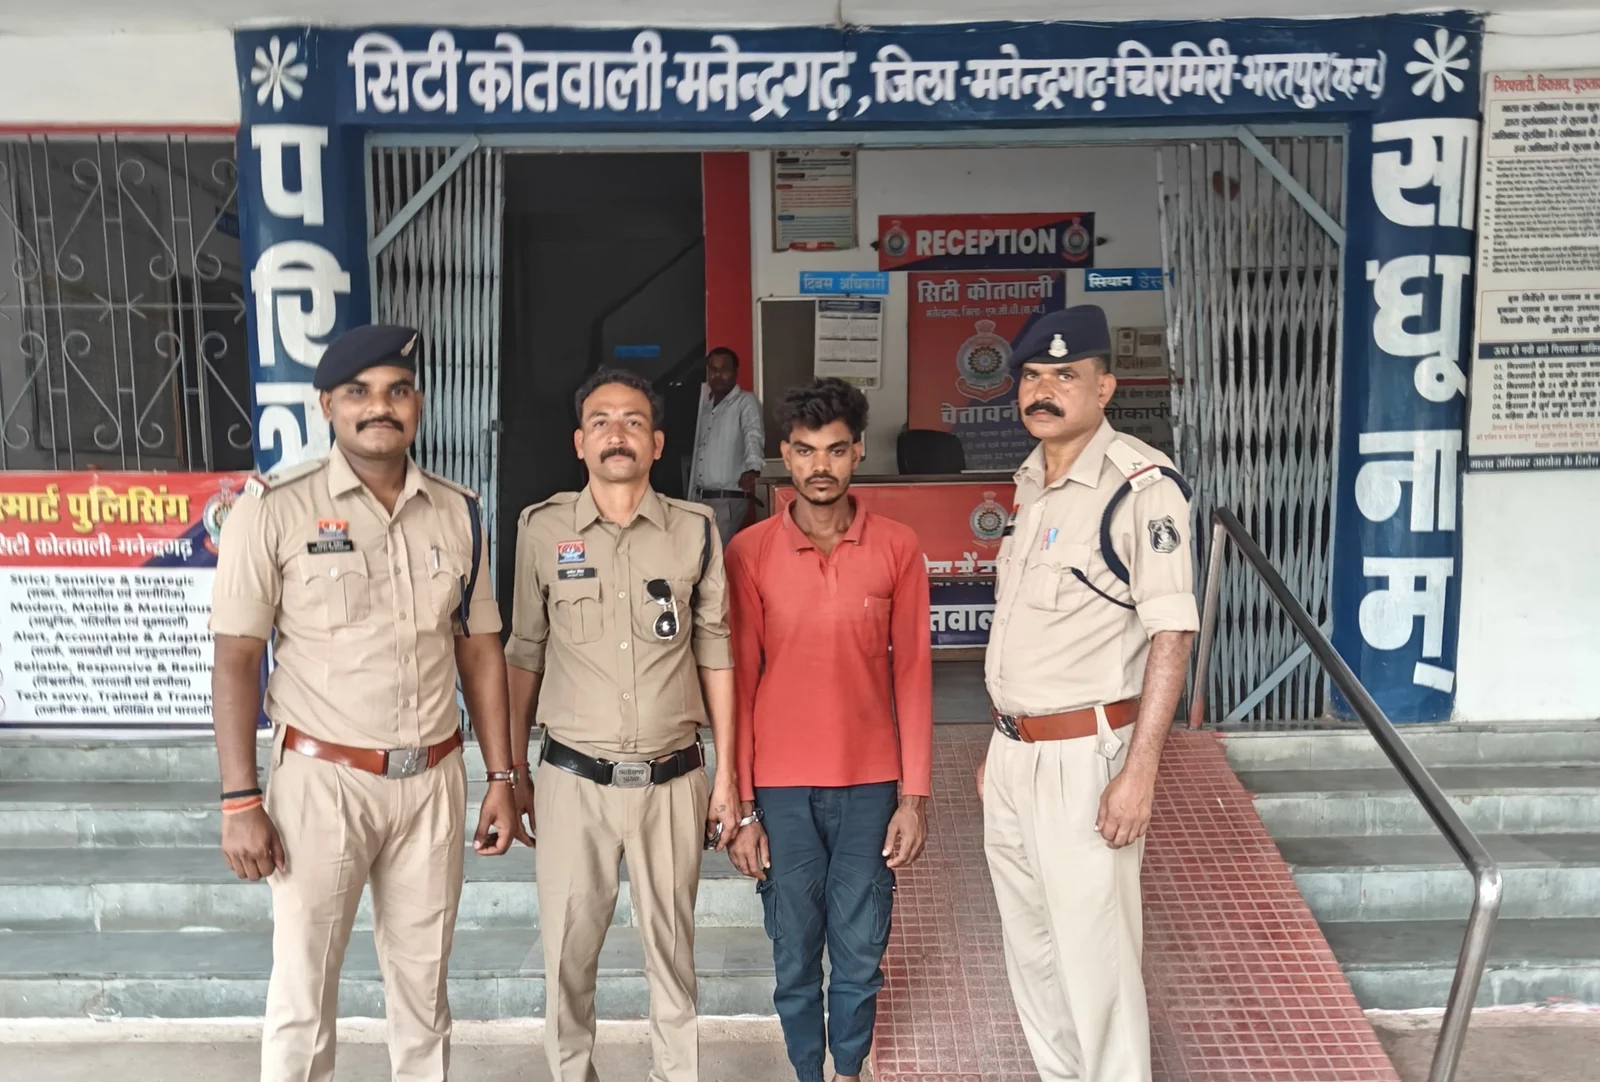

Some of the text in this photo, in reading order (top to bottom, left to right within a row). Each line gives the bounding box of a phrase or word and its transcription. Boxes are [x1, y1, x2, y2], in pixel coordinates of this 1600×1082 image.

[348, 29, 463, 114] सिटी
[916, 228, 1057, 256] RECEPTION
[917, 275, 1056, 303] सिटी कोतवाली
[940, 400, 1019, 424] चेतावन
[67, 485, 190, 535] पुलिसिंग
[55, 573, 115, 587] Sensitive
[134, 573, 195, 588] Strategic
[72, 601, 119, 614] Mobile
[55, 631, 138, 643] Accountable
[77, 661, 152, 674] Responsive
[15, 689, 48, 702] Tech
[97, 689, 149, 702] Trained
